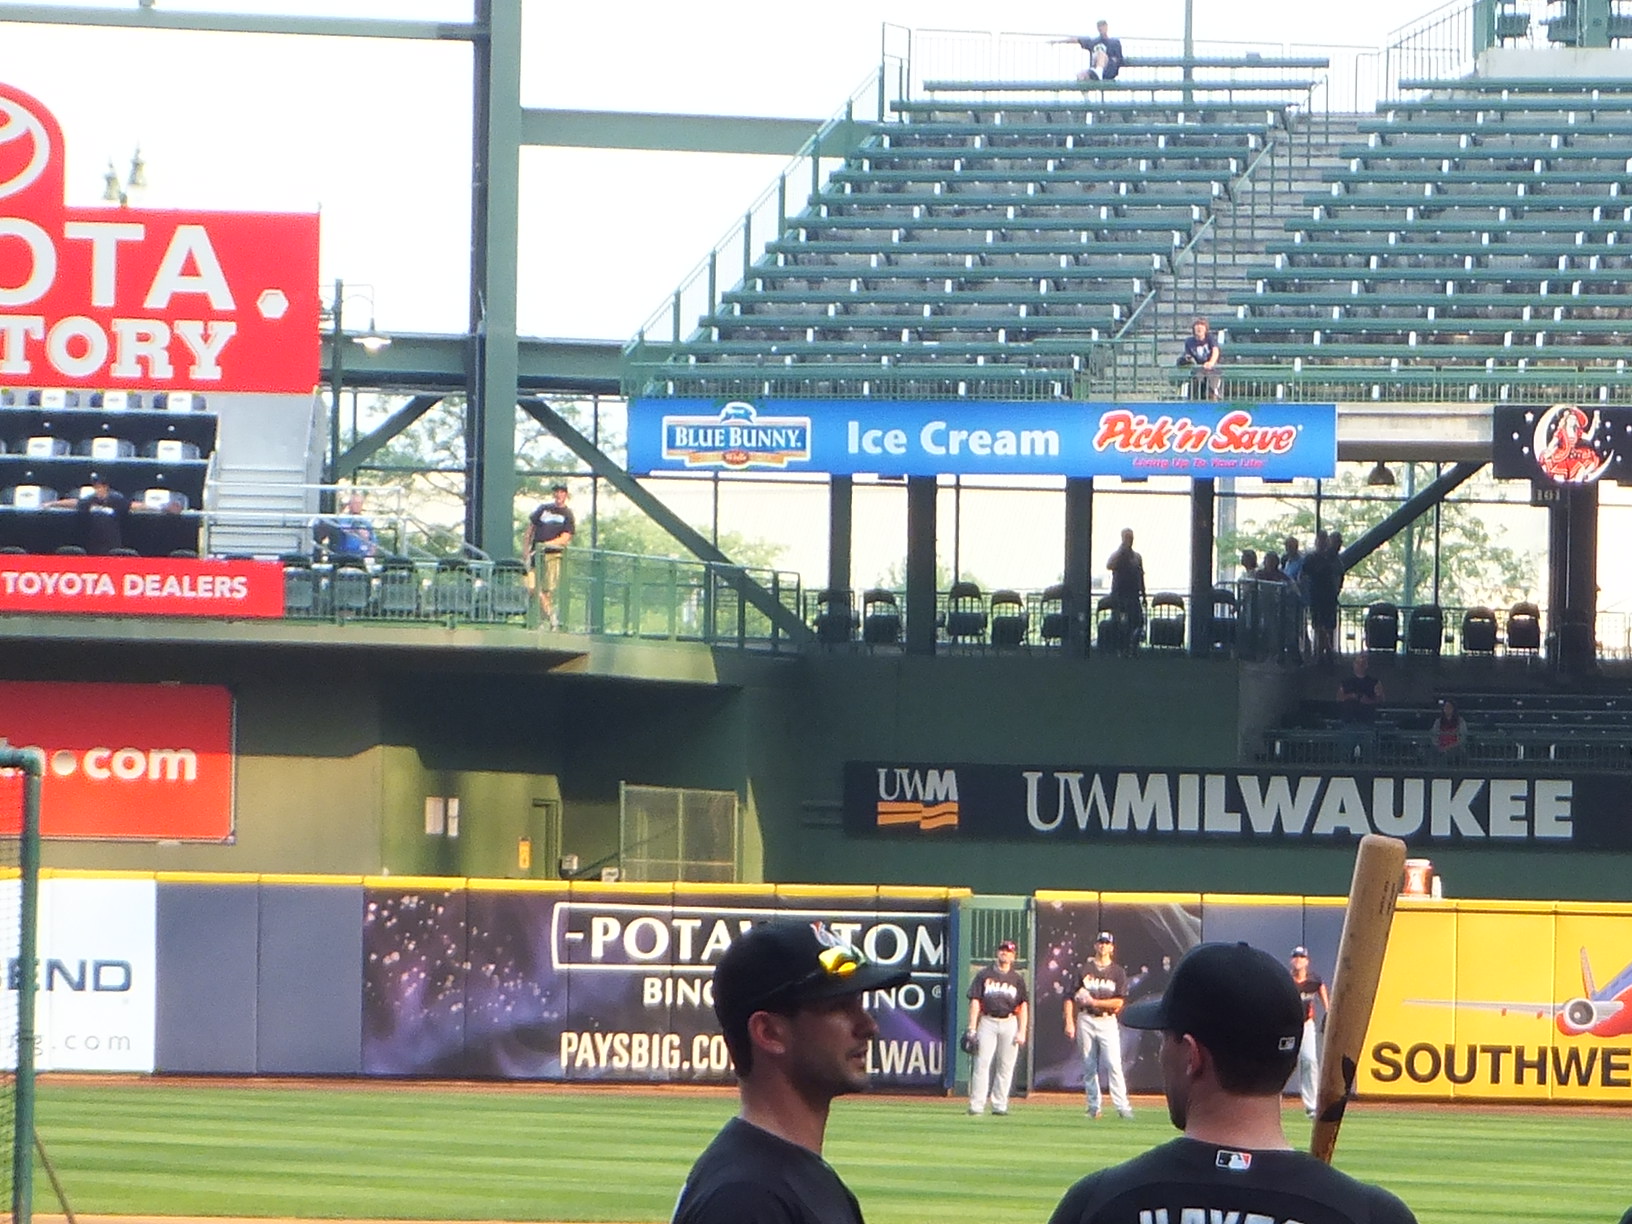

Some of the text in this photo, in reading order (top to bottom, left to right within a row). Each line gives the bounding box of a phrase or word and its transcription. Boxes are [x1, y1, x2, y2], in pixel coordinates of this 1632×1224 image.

[675, 426, 725, 447] BLUE
[848, 420, 1060, 456] Ice Cream
[1094, 411, 1297, 453] Pick'n Save
[1, 571, 249, 599] TOYOTA DEALERS
[876, 768, 958, 801] UWM
[560, 1032, 735, 1070] PAYSBIG.CO
